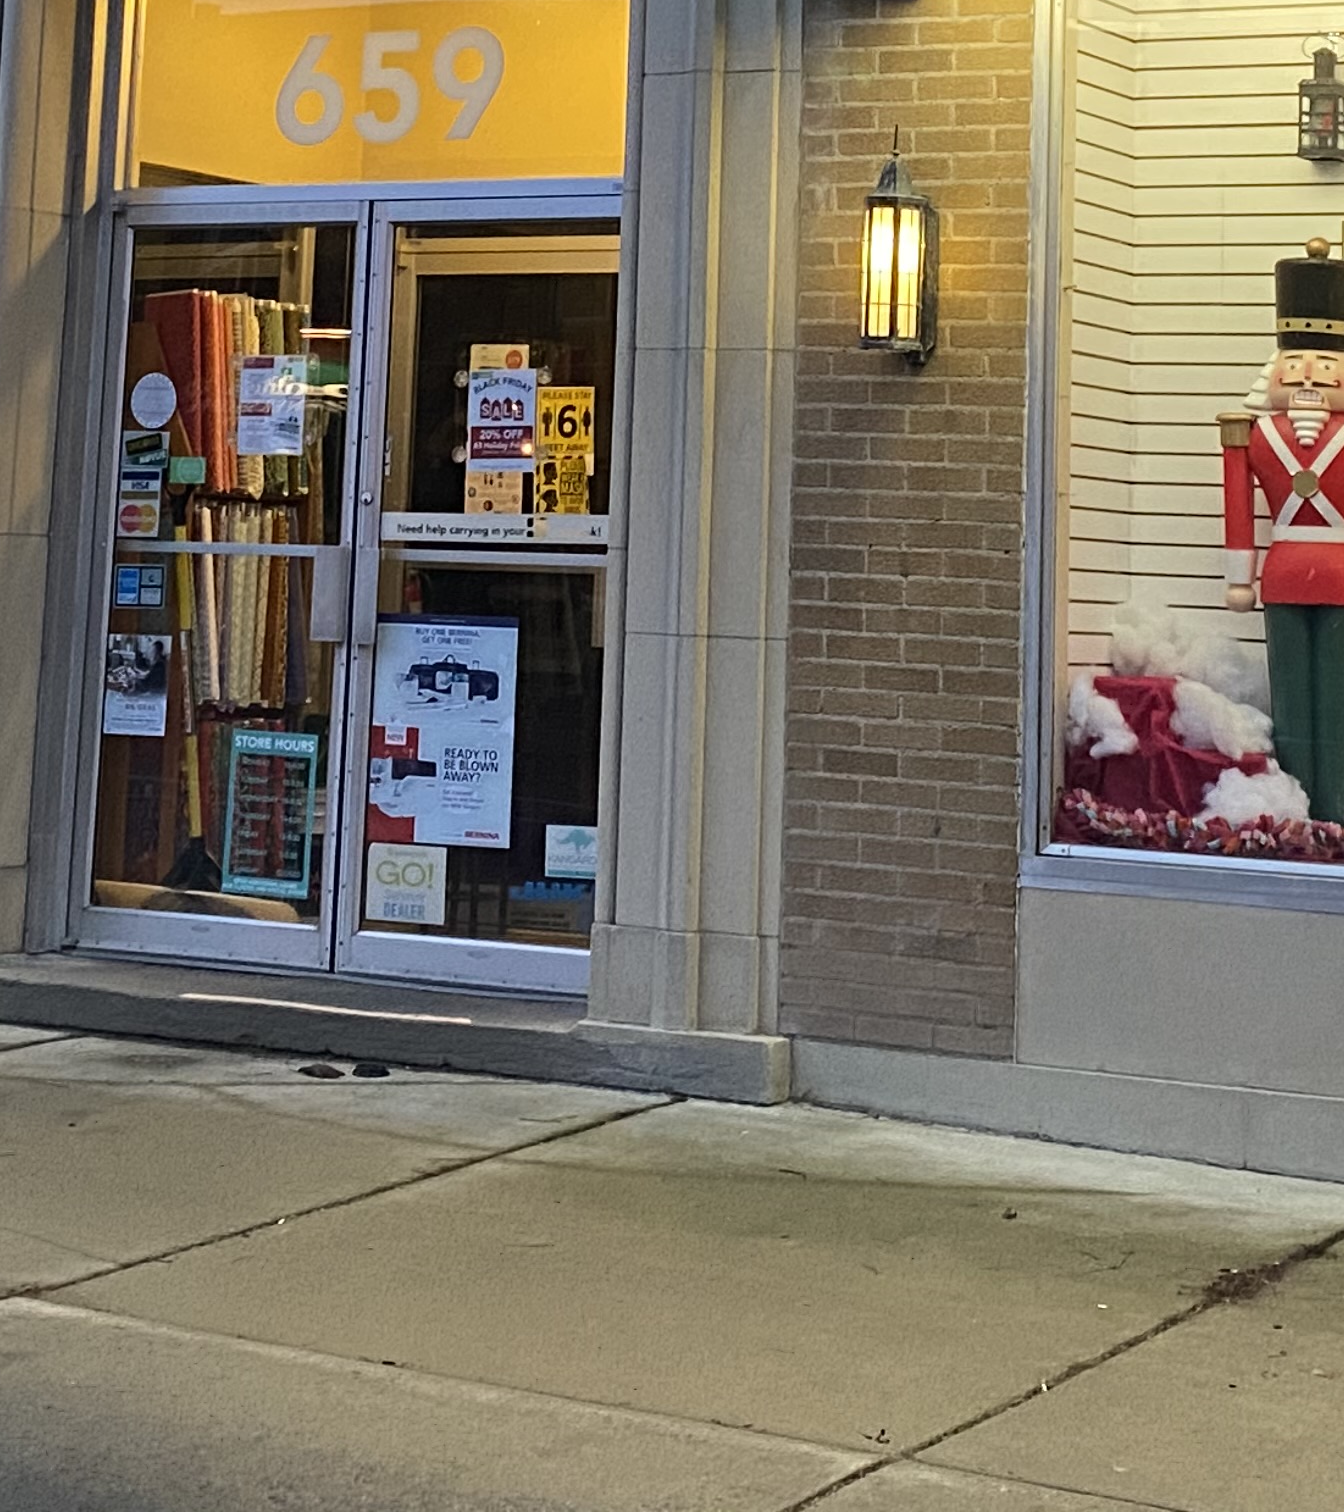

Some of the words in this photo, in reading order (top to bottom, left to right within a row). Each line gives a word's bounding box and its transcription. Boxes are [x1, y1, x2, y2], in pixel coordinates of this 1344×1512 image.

[275, 25, 505, 146] 659
[473, 377, 502, 394] BLACK
[503, 376, 533, 393] FRIDAY
[542, 390, 573, 400] PLEASE
[574, 390, 592, 400] STAY
[480, 399, 524, 421] SALE
[557, 404, 578, 438] 6
[479, 429, 502, 440] 20%
[504, 428, 524, 439] OFF
[566, 443, 590, 452] AWAY
[131, 481, 150, 490] VISA
[397, 524, 423, 534] Need
[425, 524, 447, 536] help
[449, 526, 490, 537] carrying
[492, 527, 501, 535] in
[503, 527, 526, 538] your
[235, 735, 272, 750] STORE
[274, 738, 315, 753] HOURS
[444, 748, 481, 760] READY
[482, 750, 498, 761] TO
[443, 759, 456, 770] BE
[458, 760, 499, 773] BLOWN
[442, 771, 481, 783] AWAY?
[463, 831, 500, 841] BERNINA
[376, 860, 434, 889] GO!
[383, 902, 426, 920] DEALER
